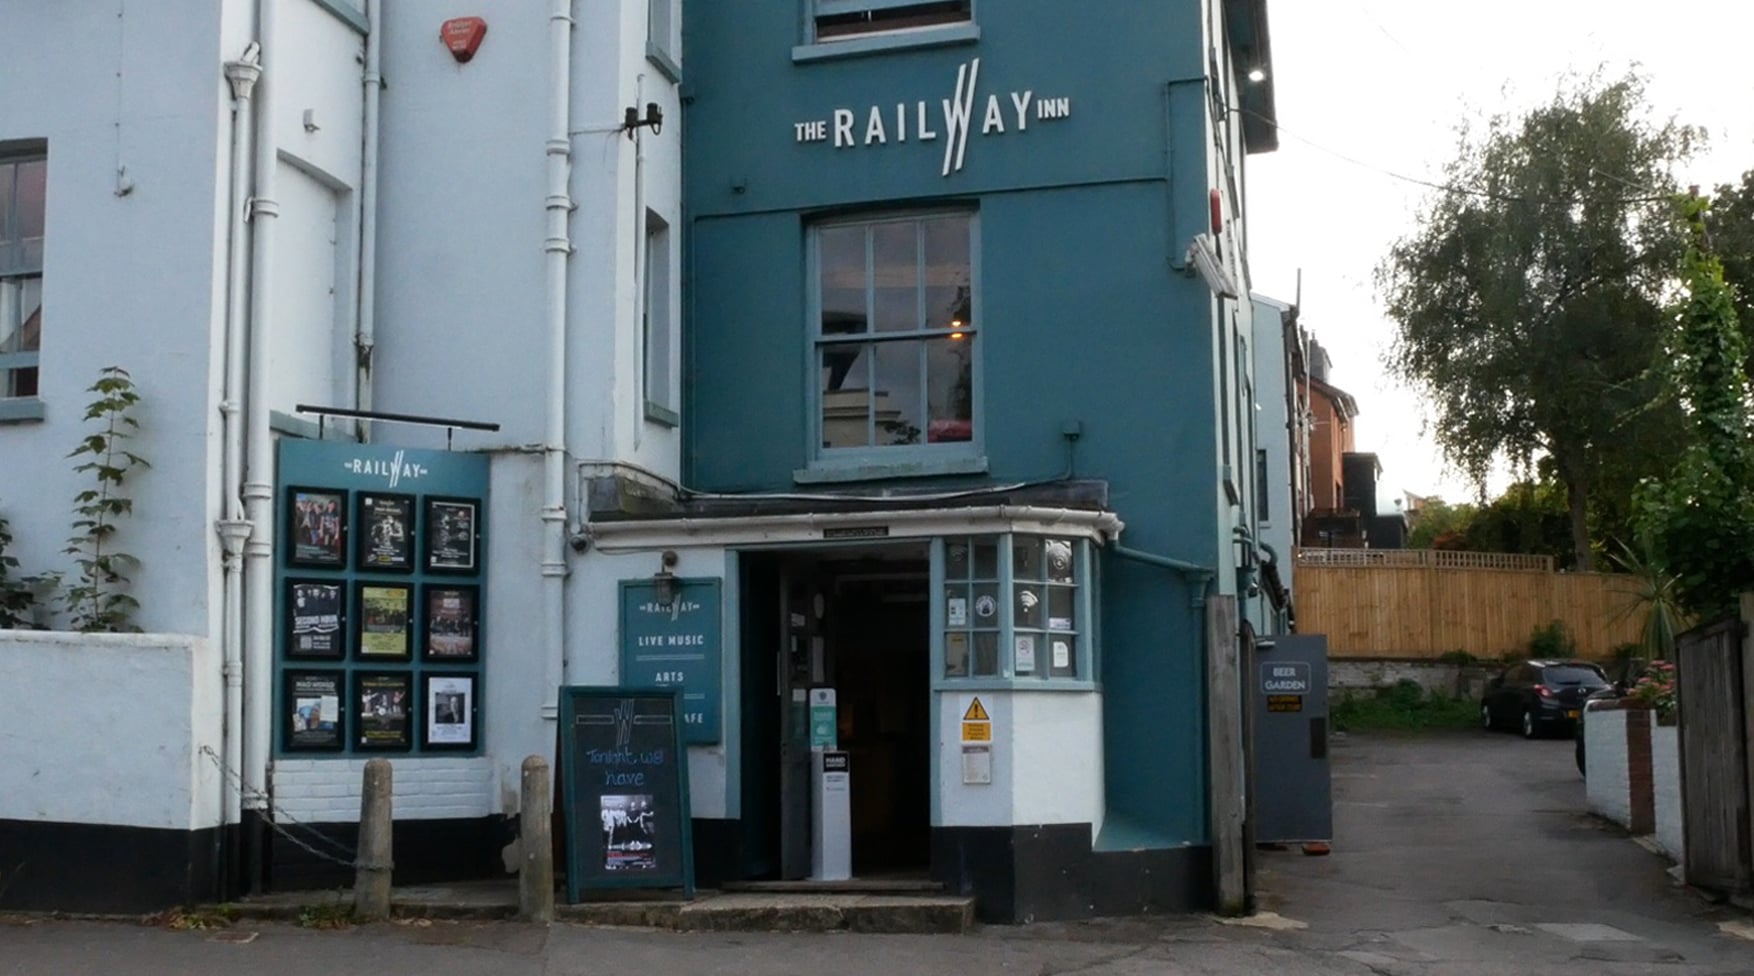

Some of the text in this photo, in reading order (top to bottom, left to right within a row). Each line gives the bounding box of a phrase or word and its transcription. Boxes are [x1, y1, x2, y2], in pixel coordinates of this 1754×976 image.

[794, 57, 1070, 176] THE RAILWAY INN
[353, 449, 421, 489] RAILWAY
[638, 634, 704, 646] LIVE MUSIC
[655, 671, 684, 682] ARTS
[1273, 667, 1296, 677] BEER
[1264, 680, 1306, 690] GARDEN
[605, 769, 645, 786] have
